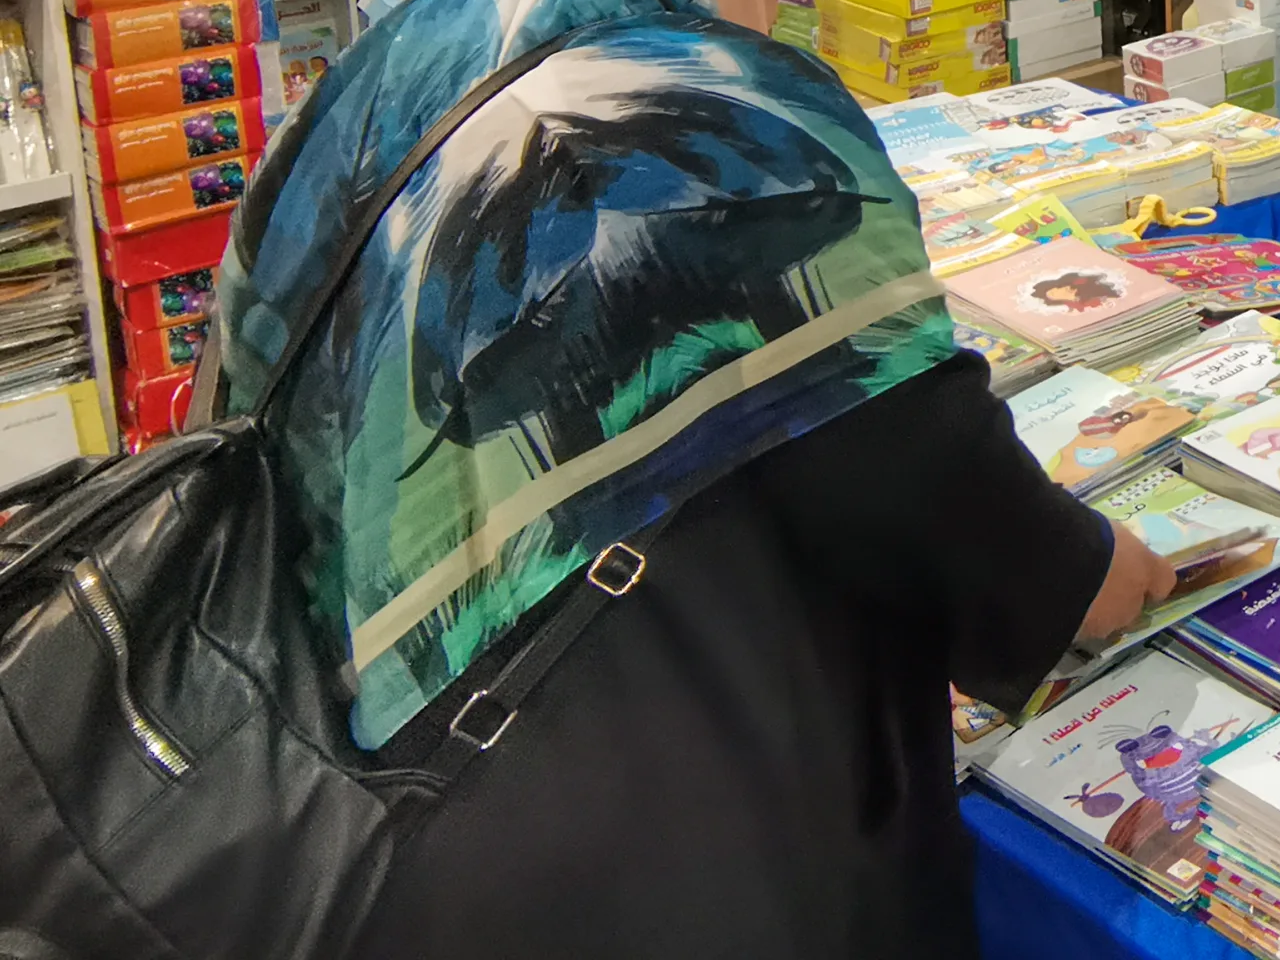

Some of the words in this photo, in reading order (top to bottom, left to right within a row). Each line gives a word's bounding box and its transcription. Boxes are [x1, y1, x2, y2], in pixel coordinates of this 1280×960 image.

[1251, 352, 1268, 367] في
[1099, 684, 1139, 709] رسالة
[1081, 707, 1103, 723] من
